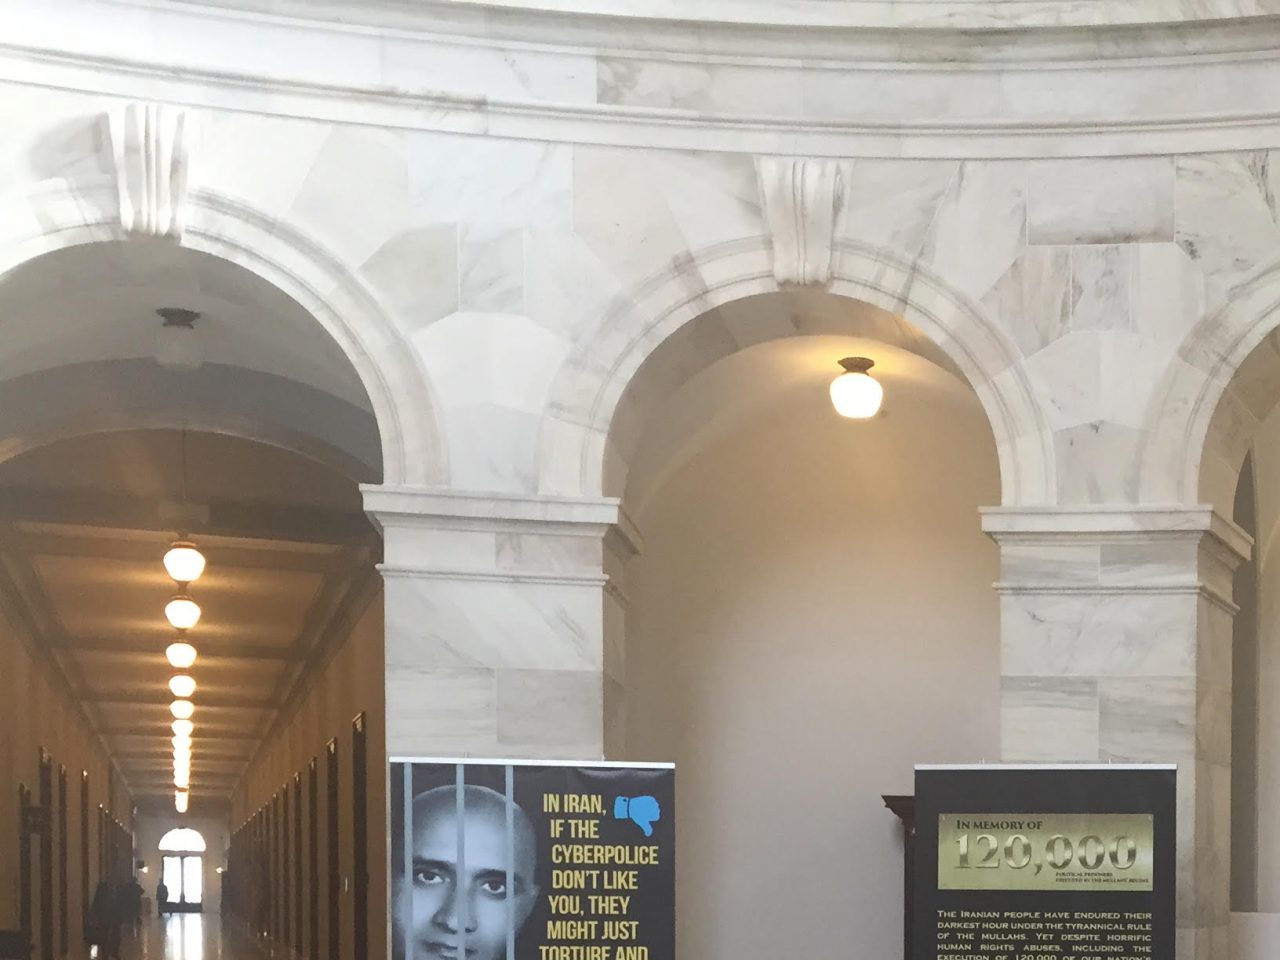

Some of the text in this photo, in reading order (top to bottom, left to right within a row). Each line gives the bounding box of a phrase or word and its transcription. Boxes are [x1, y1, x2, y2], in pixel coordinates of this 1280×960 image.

[544, 794, 606, 814] IN IRAN,
[551, 820, 599, 838] IF THE
[957, 820, 1043, 830] IN MEMORY OF
[552, 845, 659, 864] CYBERPOLICE
[956, 834, 1137, 876] 120,000
[552, 870, 638, 889] DON'T LIKE
[548, 896, 629, 915] YOU, THEY
[1004, 911, 1040, 919] PEOPLE
[1045, 911, 1070, 919] HAVE
[1124, 912, 1152, 920] THEIR
[548, 921, 639, 940] MIGHT JUST
[1011, 922, 1043, 930] UNDER
[1036, 933, 1053, 941] YET
[1061, 933, 1100, 941] DESPITE
